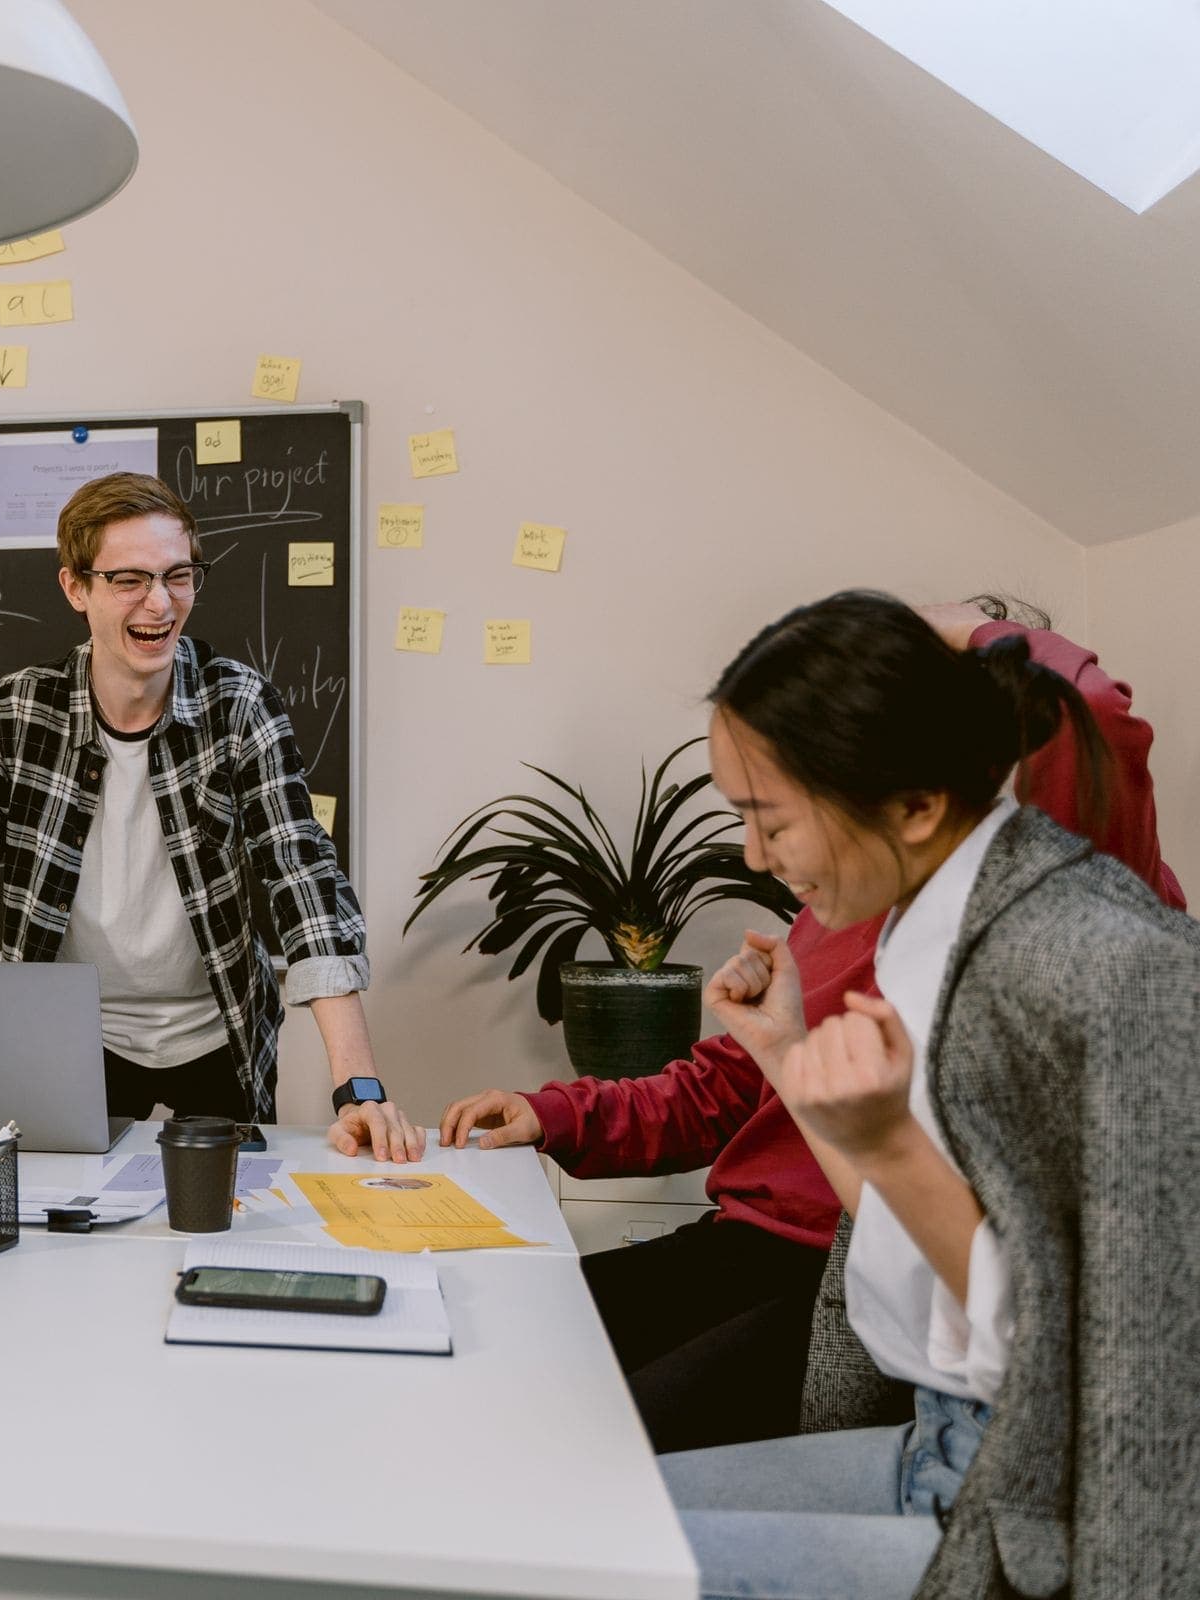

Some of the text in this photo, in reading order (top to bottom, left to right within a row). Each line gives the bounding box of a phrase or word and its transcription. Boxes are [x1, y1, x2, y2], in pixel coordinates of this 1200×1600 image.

[205, 431, 222, 448] ad
[176, 446, 329, 519] Our project
